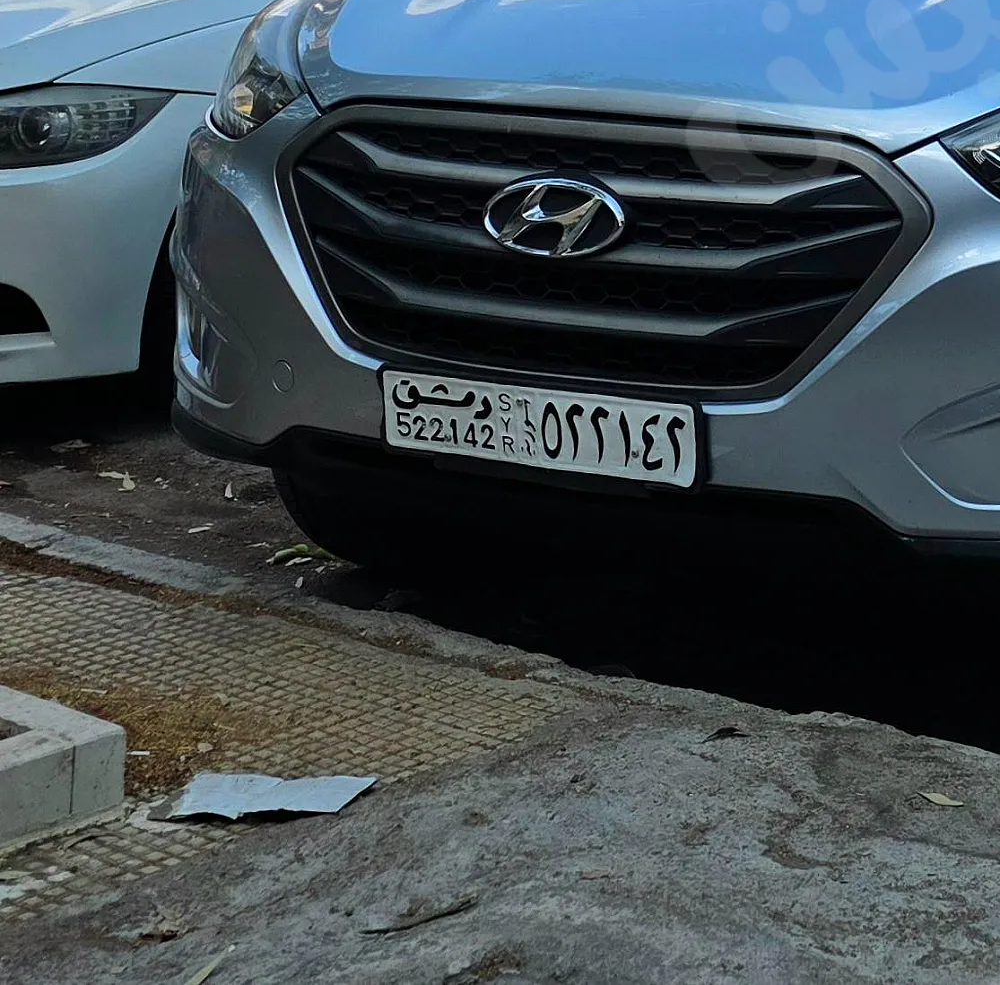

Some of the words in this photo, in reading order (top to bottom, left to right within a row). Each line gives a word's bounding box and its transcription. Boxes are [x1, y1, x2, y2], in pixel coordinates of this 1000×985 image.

[392, 380, 492, 419] دمشق
[396, 411, 496, 450] 522142
[541, 401, 686, 473] ٥٢٢١٤٢
